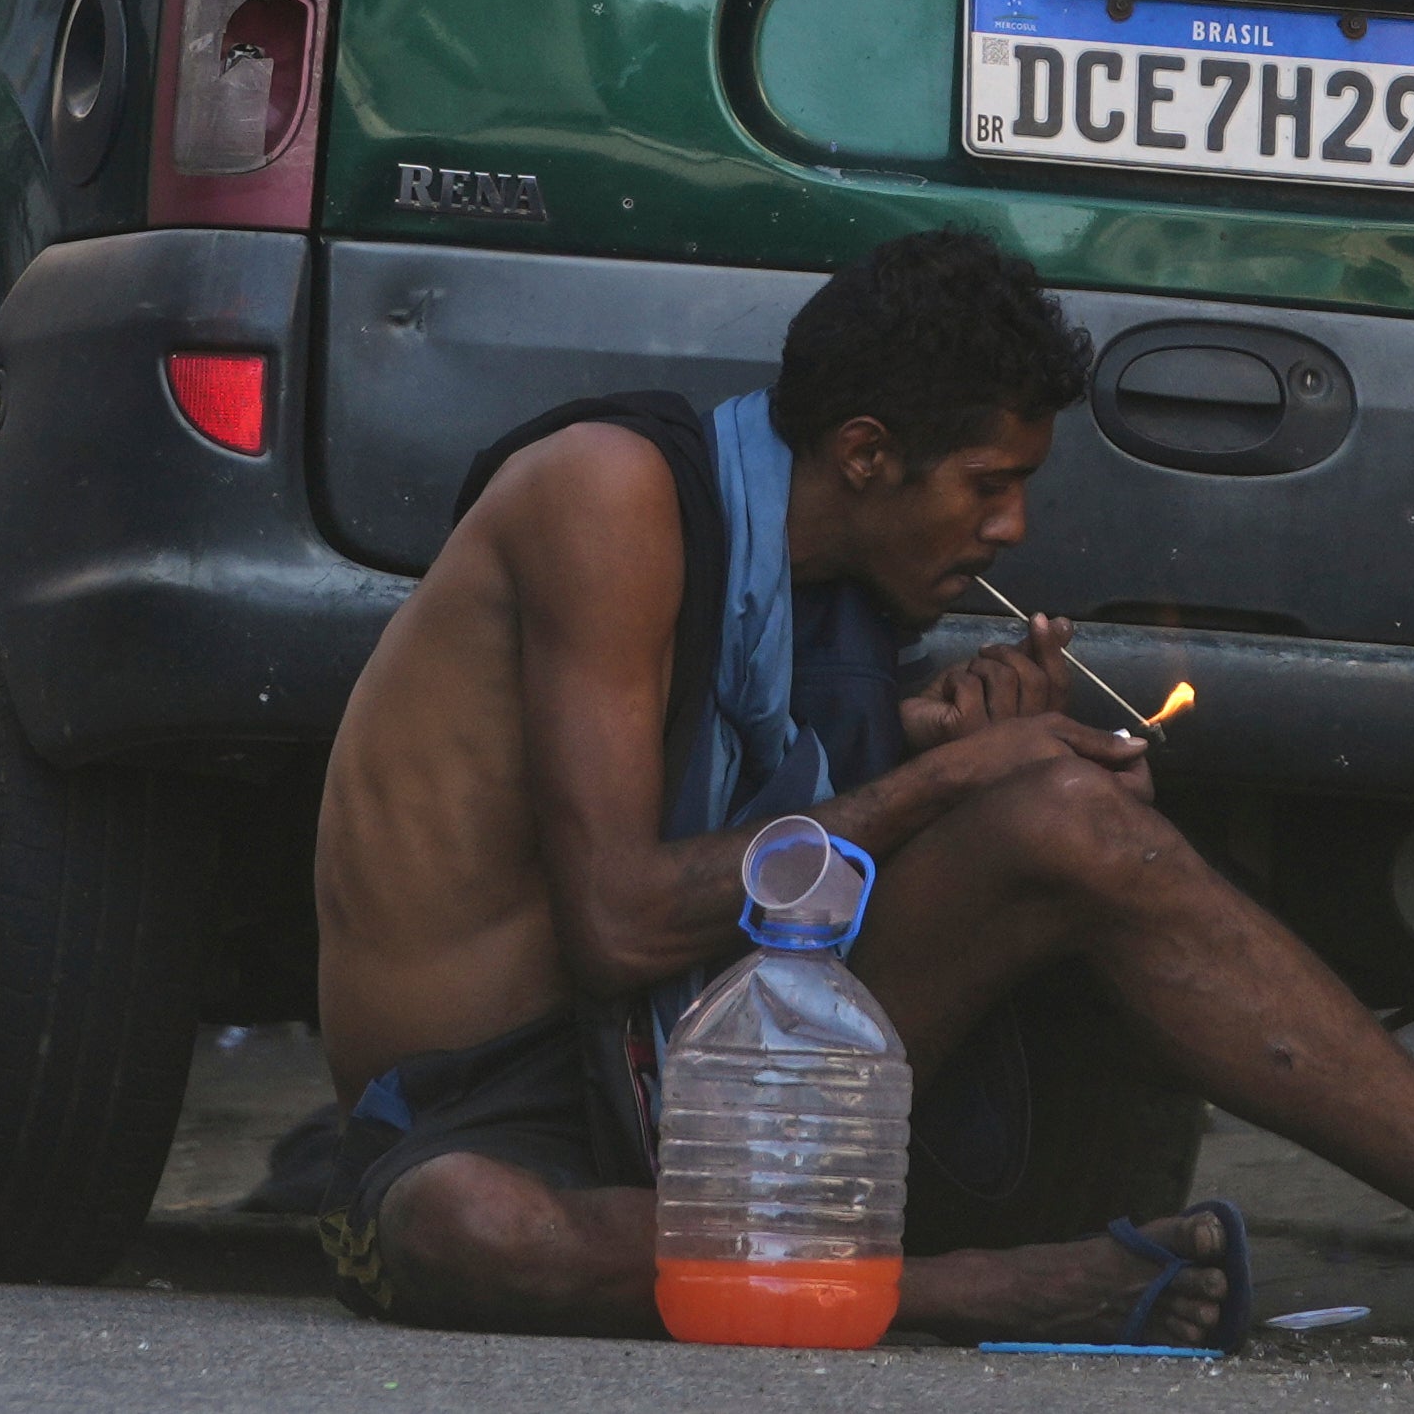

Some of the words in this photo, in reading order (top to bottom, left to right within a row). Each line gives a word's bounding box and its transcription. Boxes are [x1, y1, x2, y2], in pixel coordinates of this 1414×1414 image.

[994, 21, 1038, 32] MERCOSUL
[1192, 20, 1274, 47] BRASIL
[977, 114, 1004, 143] BR
[394, 163, 548, 221] RENA
